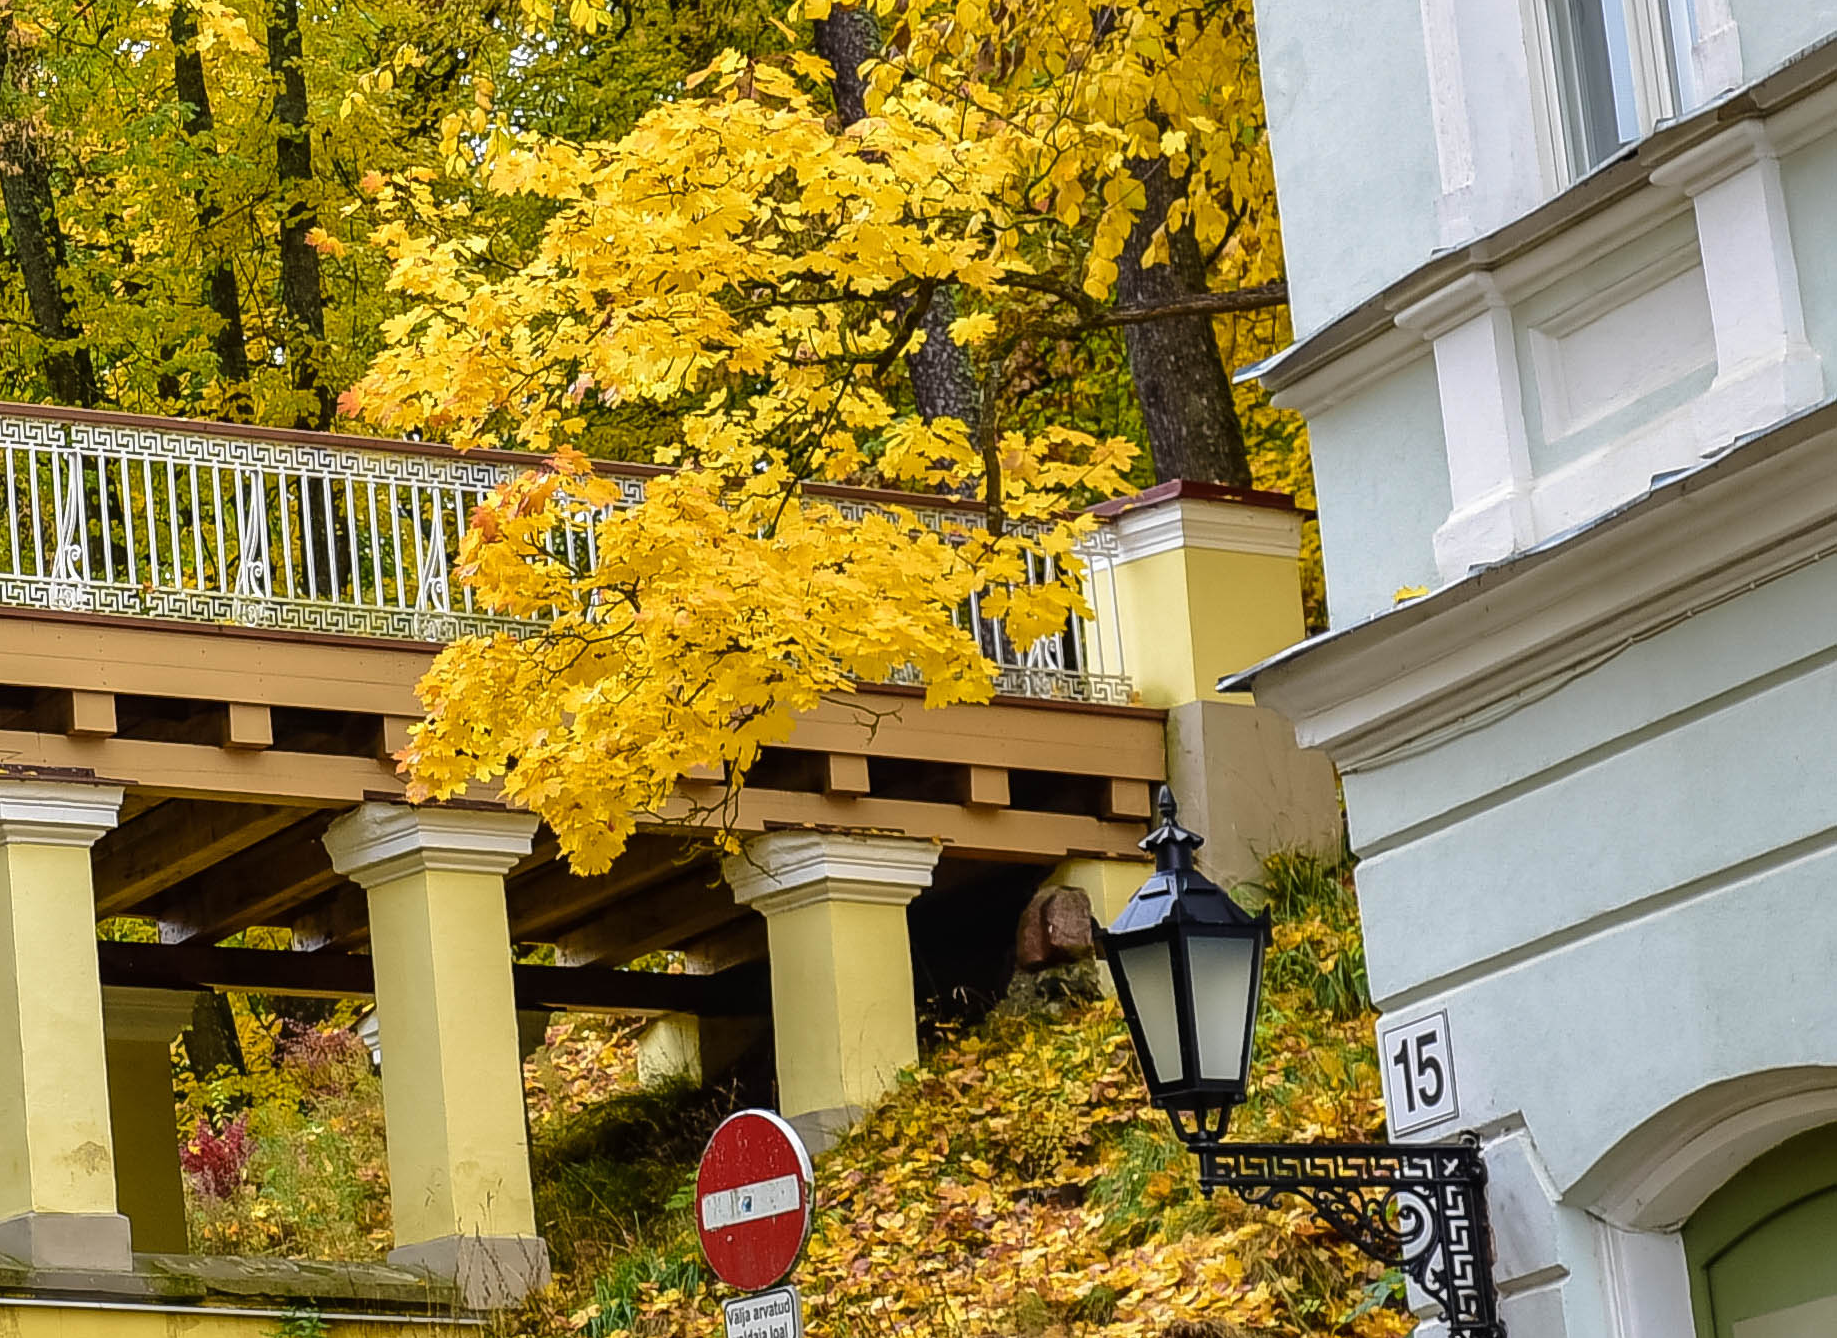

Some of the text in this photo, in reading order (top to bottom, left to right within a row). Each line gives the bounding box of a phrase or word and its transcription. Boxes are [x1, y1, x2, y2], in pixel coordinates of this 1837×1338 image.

[1393, 1030, 1444, 1113] 15
[727, 1297, 790, 1327] Välja arvatud
